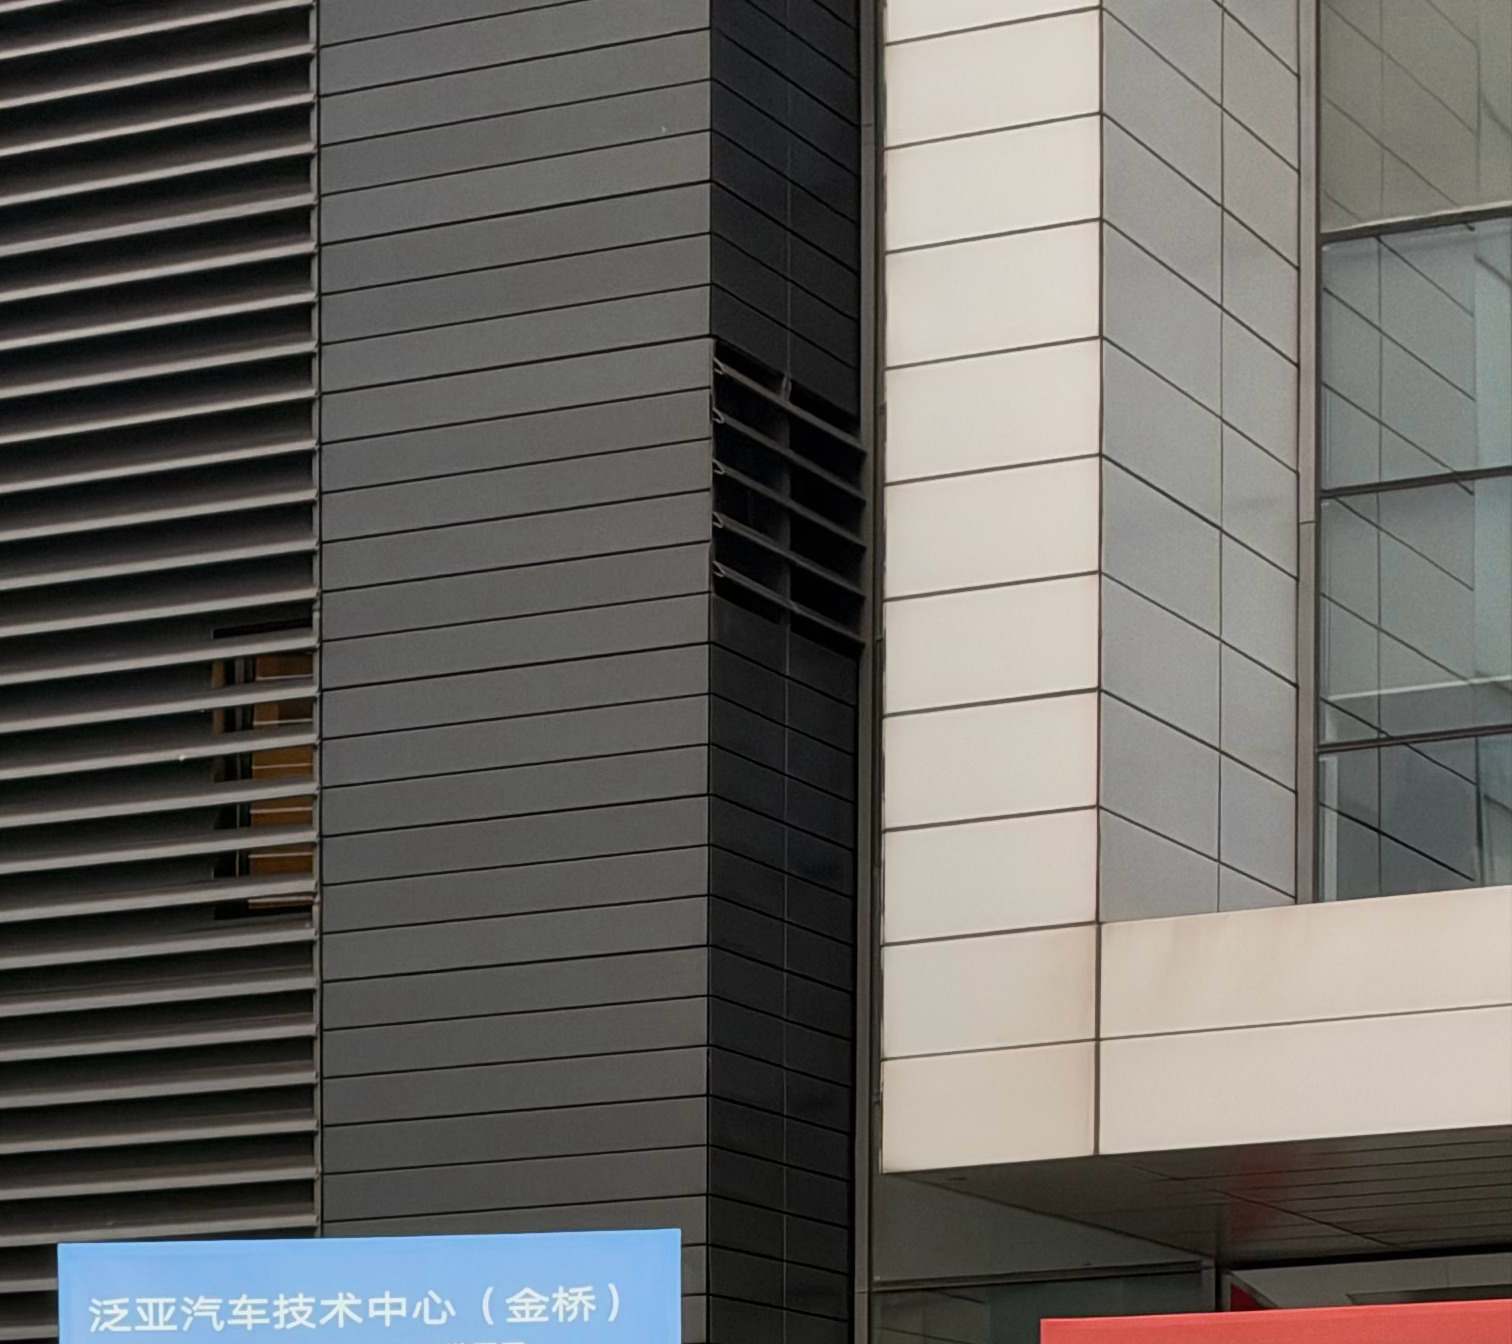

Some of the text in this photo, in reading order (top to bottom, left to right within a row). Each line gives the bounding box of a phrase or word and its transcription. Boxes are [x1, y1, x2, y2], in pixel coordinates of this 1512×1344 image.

[88, 1283, 621, 1333] 泛亚汽车技术中心（金桥）
